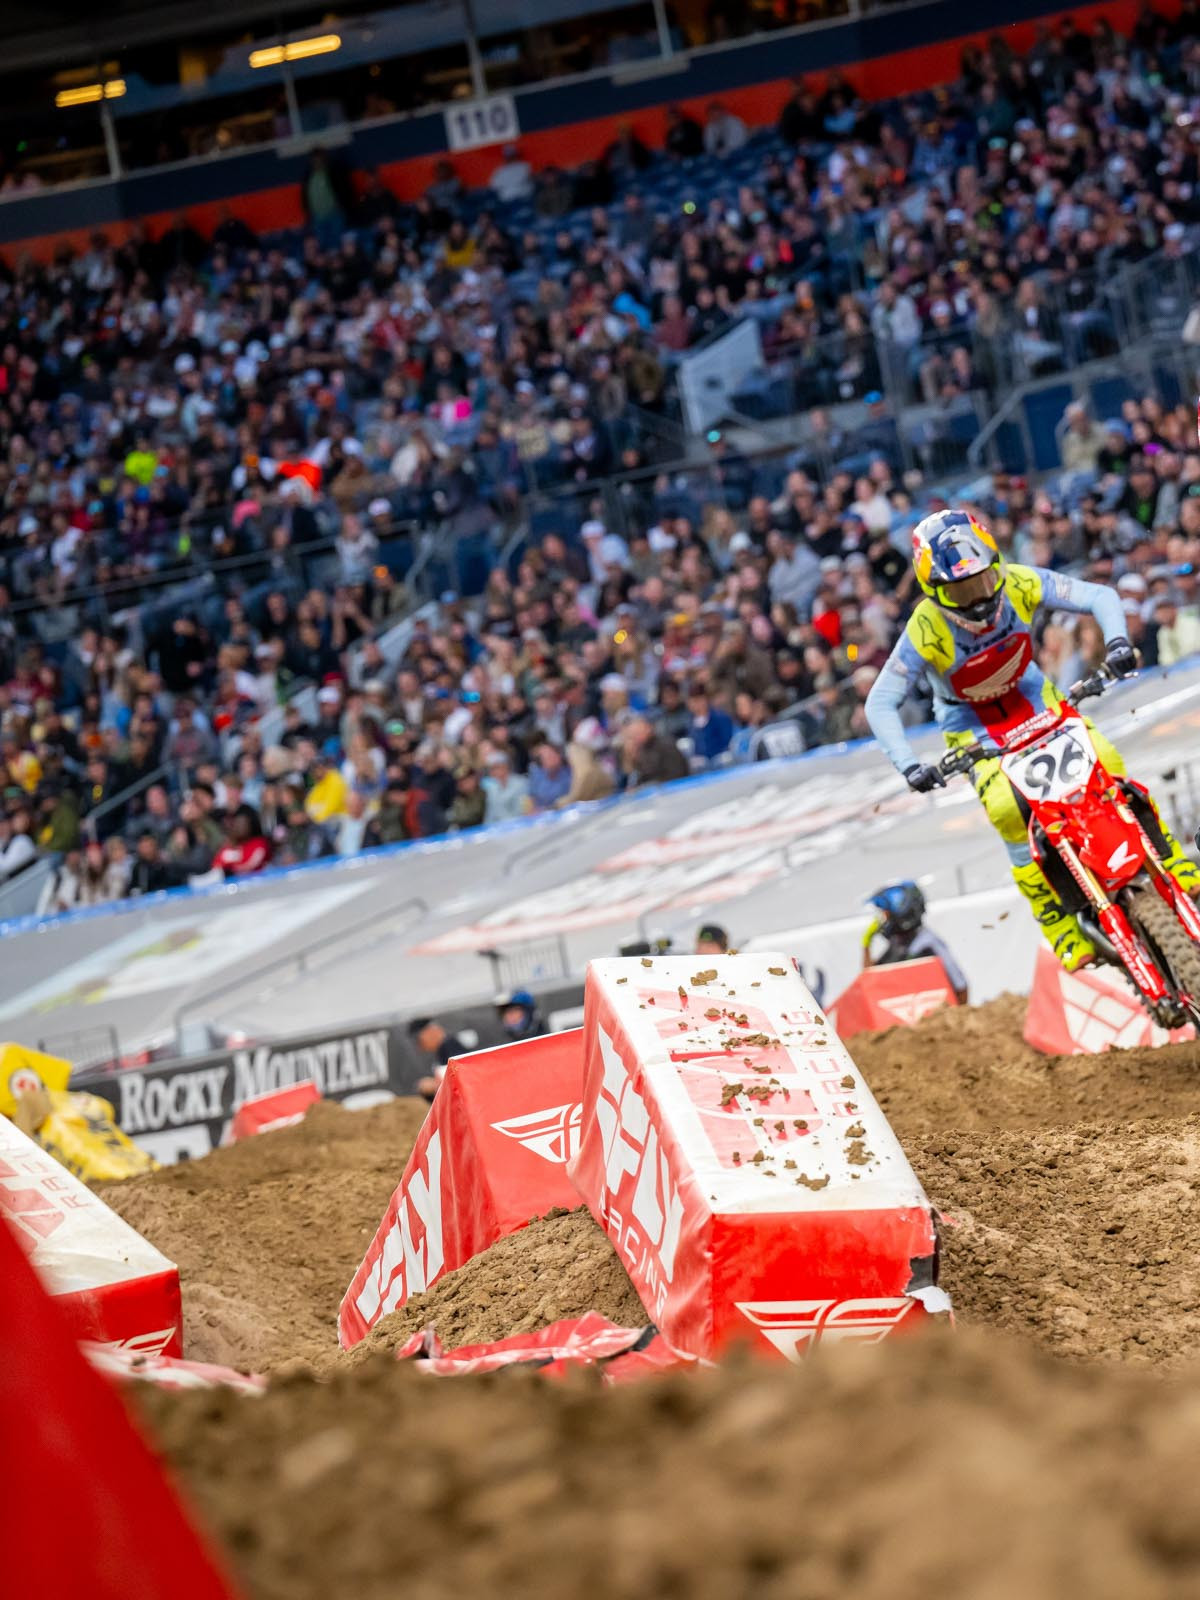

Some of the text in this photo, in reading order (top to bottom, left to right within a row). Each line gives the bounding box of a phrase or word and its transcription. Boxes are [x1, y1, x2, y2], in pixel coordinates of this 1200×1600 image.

[457, 104, 509, 141] 110
[1025, 740, 1083, 800] 96
[119, 1030, 390, 1133] ROCKY MOUNTAIN
[789, 1010, 865, 1119] RACING
[598, 1182, 668, 1319] RACING
